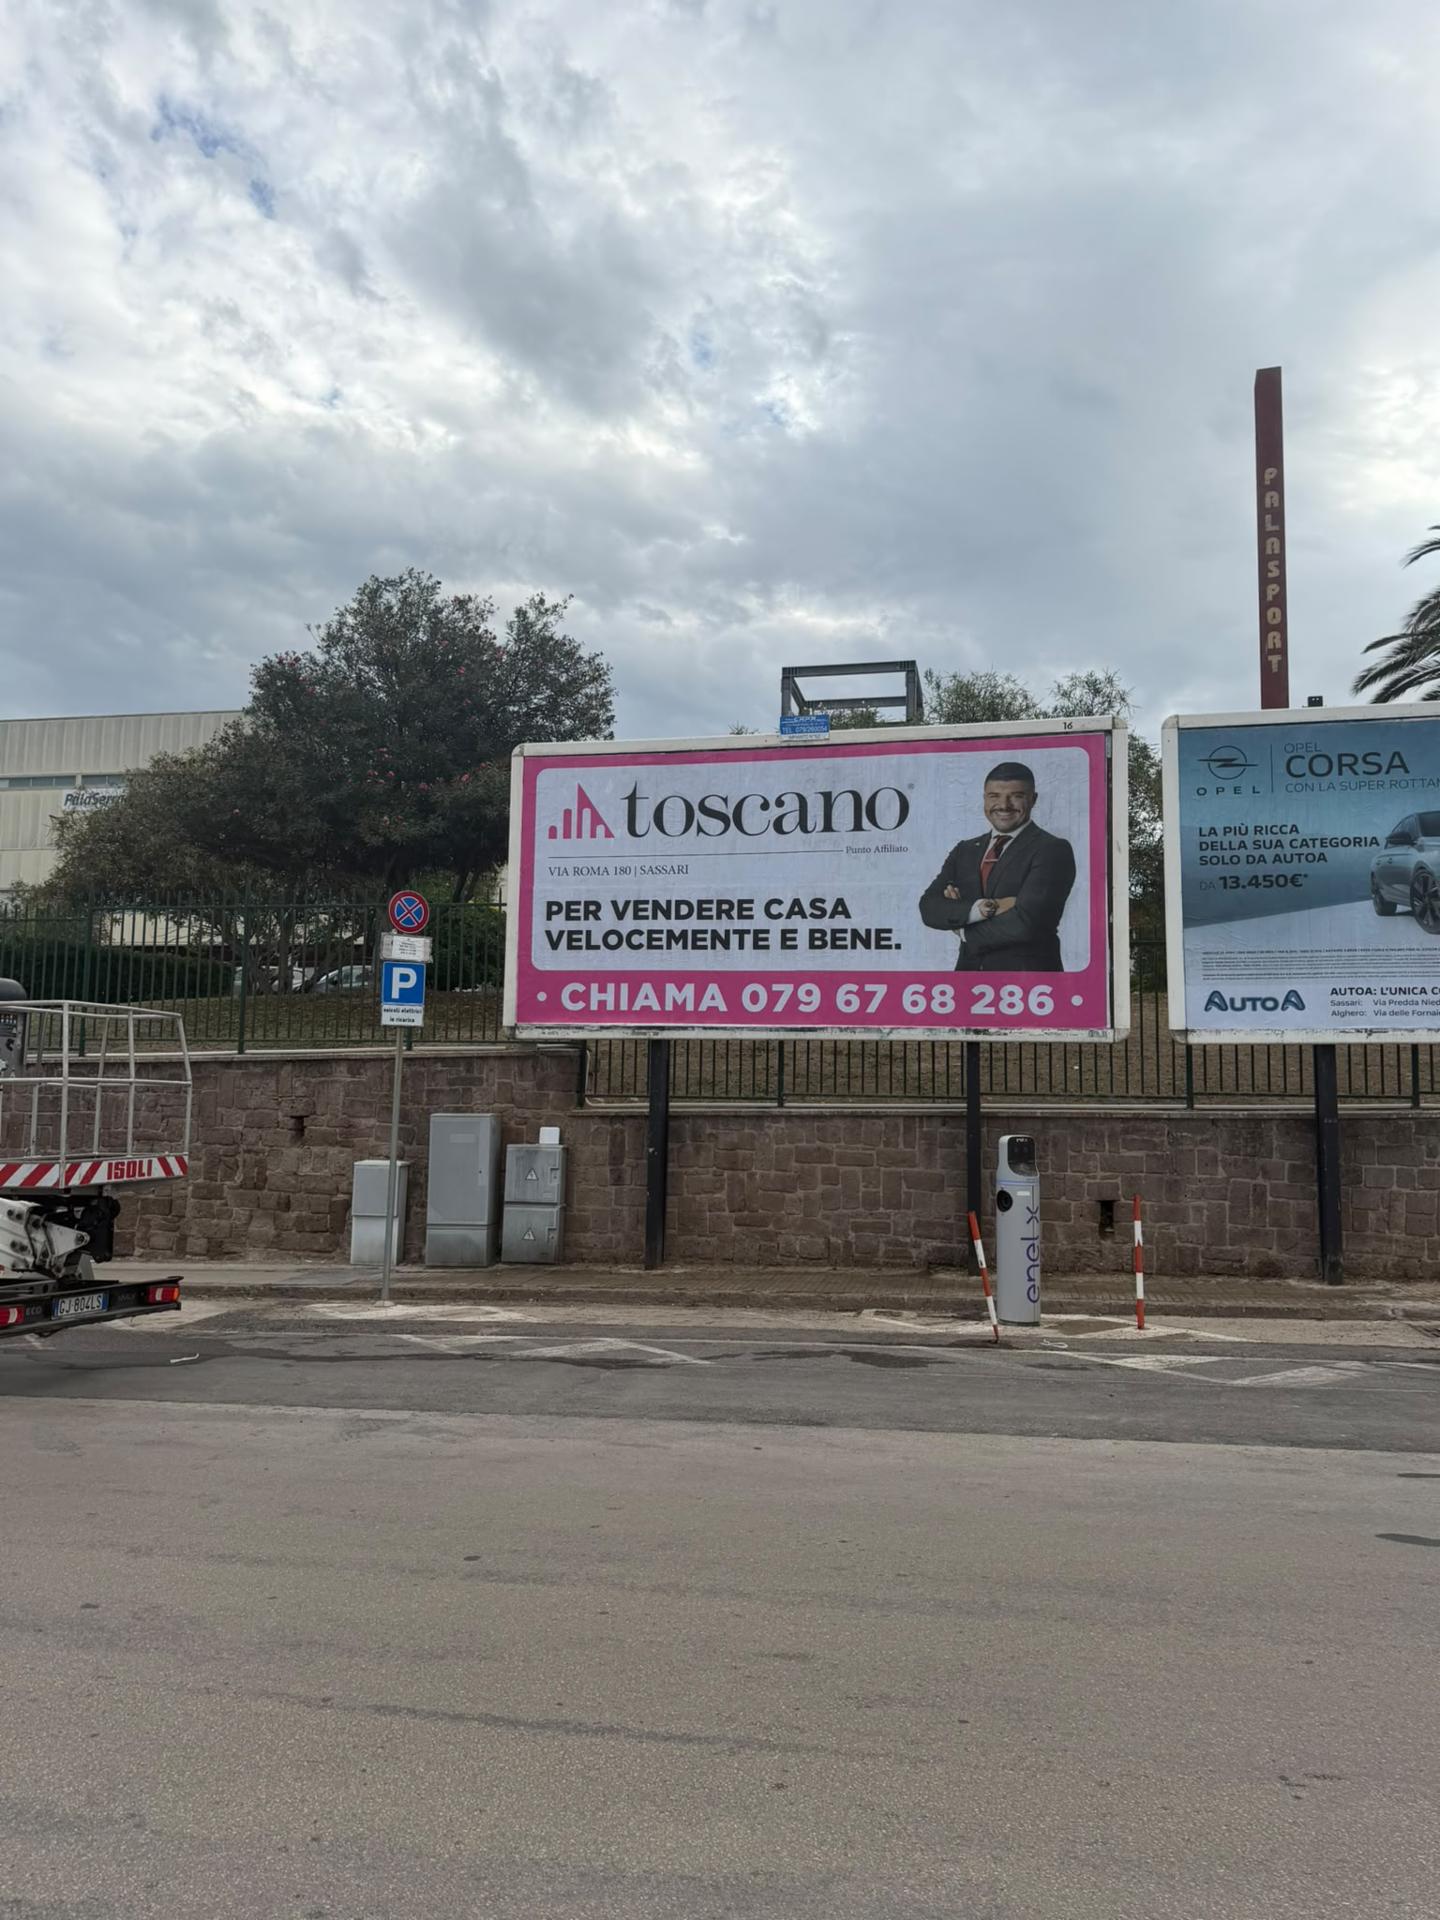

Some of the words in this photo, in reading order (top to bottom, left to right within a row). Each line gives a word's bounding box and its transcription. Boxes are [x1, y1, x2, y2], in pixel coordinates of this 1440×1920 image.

[1263, 467, 1282, 673] PALASPORT
[1064, 722, 1073, 730] 16
[1284, 742, 1321, 754] OPEL
[1285, 751, 1410, 778] CORSA
[1196, 785, 1260, 796] OPEL
[1285, 782, 1314, 793] CON
[1319, 782, 1336, 792] LA
[1342, 780, 1384, 792] SUPER
[1199, 826, 1218, 837] LA
[1223, 823, 1249, 836] PIÙ
[1254, 824, 1300, 836] RICCA
[846, 846, 871, 854] Punto
[874, 844, 908, 854] Affiliato
[1200, 840, 1247, 851] DELLA
[1252, 839, 1284, 850] SUA
[1289, 836, 1380, 849] CATEGORIA
[1200, 854, 1240, 866] SOLO
[1246, 854, 1268, 865] DA
[1272, 852, 1328, 864] AUTOA
[548, 866, 569, 876] VIA
[573, 866, 610, 876] ROMA
[614, 865, 631, 876] 180
[640, 864, 689, 876] SASSARI
[1200, 880, 1216, 891] DA
[546, 900, 602, 921] PER
[610, 899, 755, 921] VENDERE
[764, 897, 852, 920] CASA
[544, 928, 770, 950] VELOCEMENTE
[780, 928, 798, 950] E
[808, 928, 902, 950] BENE.
[392, 967, 417, 999] P
[1330, 987, 1377, 997] AUTOA:
[1380, 986, 1428, 996] L'UNICA
[1431, 986, 1440, 996] C
[560, 982, 728, 1012] CHIAMA
[742, 983, 821, 1013] 079
[836, 983, 888, 1014] 67
[902, 984, 956, 1014] 68
[970, 984, 1054, 1016] 286
[1331, 1010, 1367, 1018] Alghero:
[107, 1159, 152, 1180] ISOLI
[1020, 1235, 1040, 1304] enel
